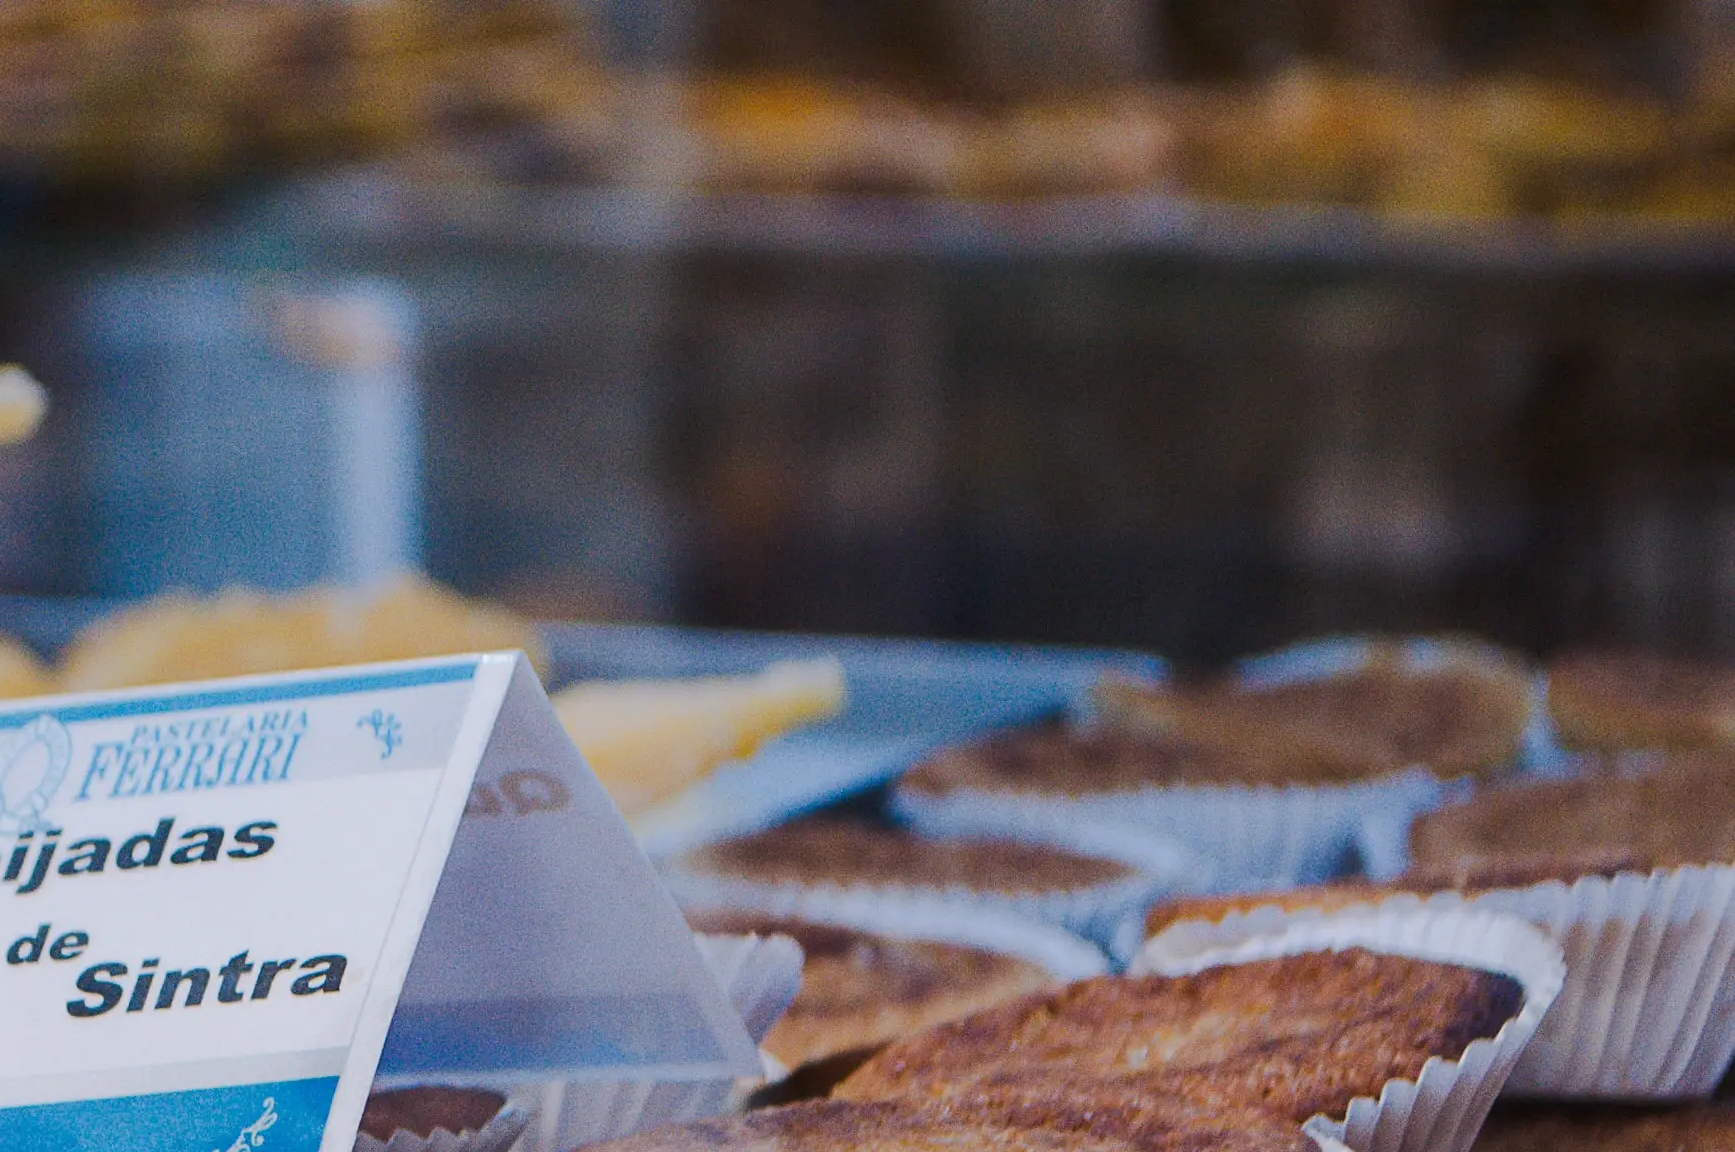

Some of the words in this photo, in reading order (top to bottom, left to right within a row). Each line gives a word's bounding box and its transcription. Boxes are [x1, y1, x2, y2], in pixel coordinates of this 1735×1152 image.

[130, 709, 308, 746] PASTELARIA
[73, 733, 302, 802] FERRARI
[6, 923, 90, 966] de
[66, 949, 348, 1019] Sintra
